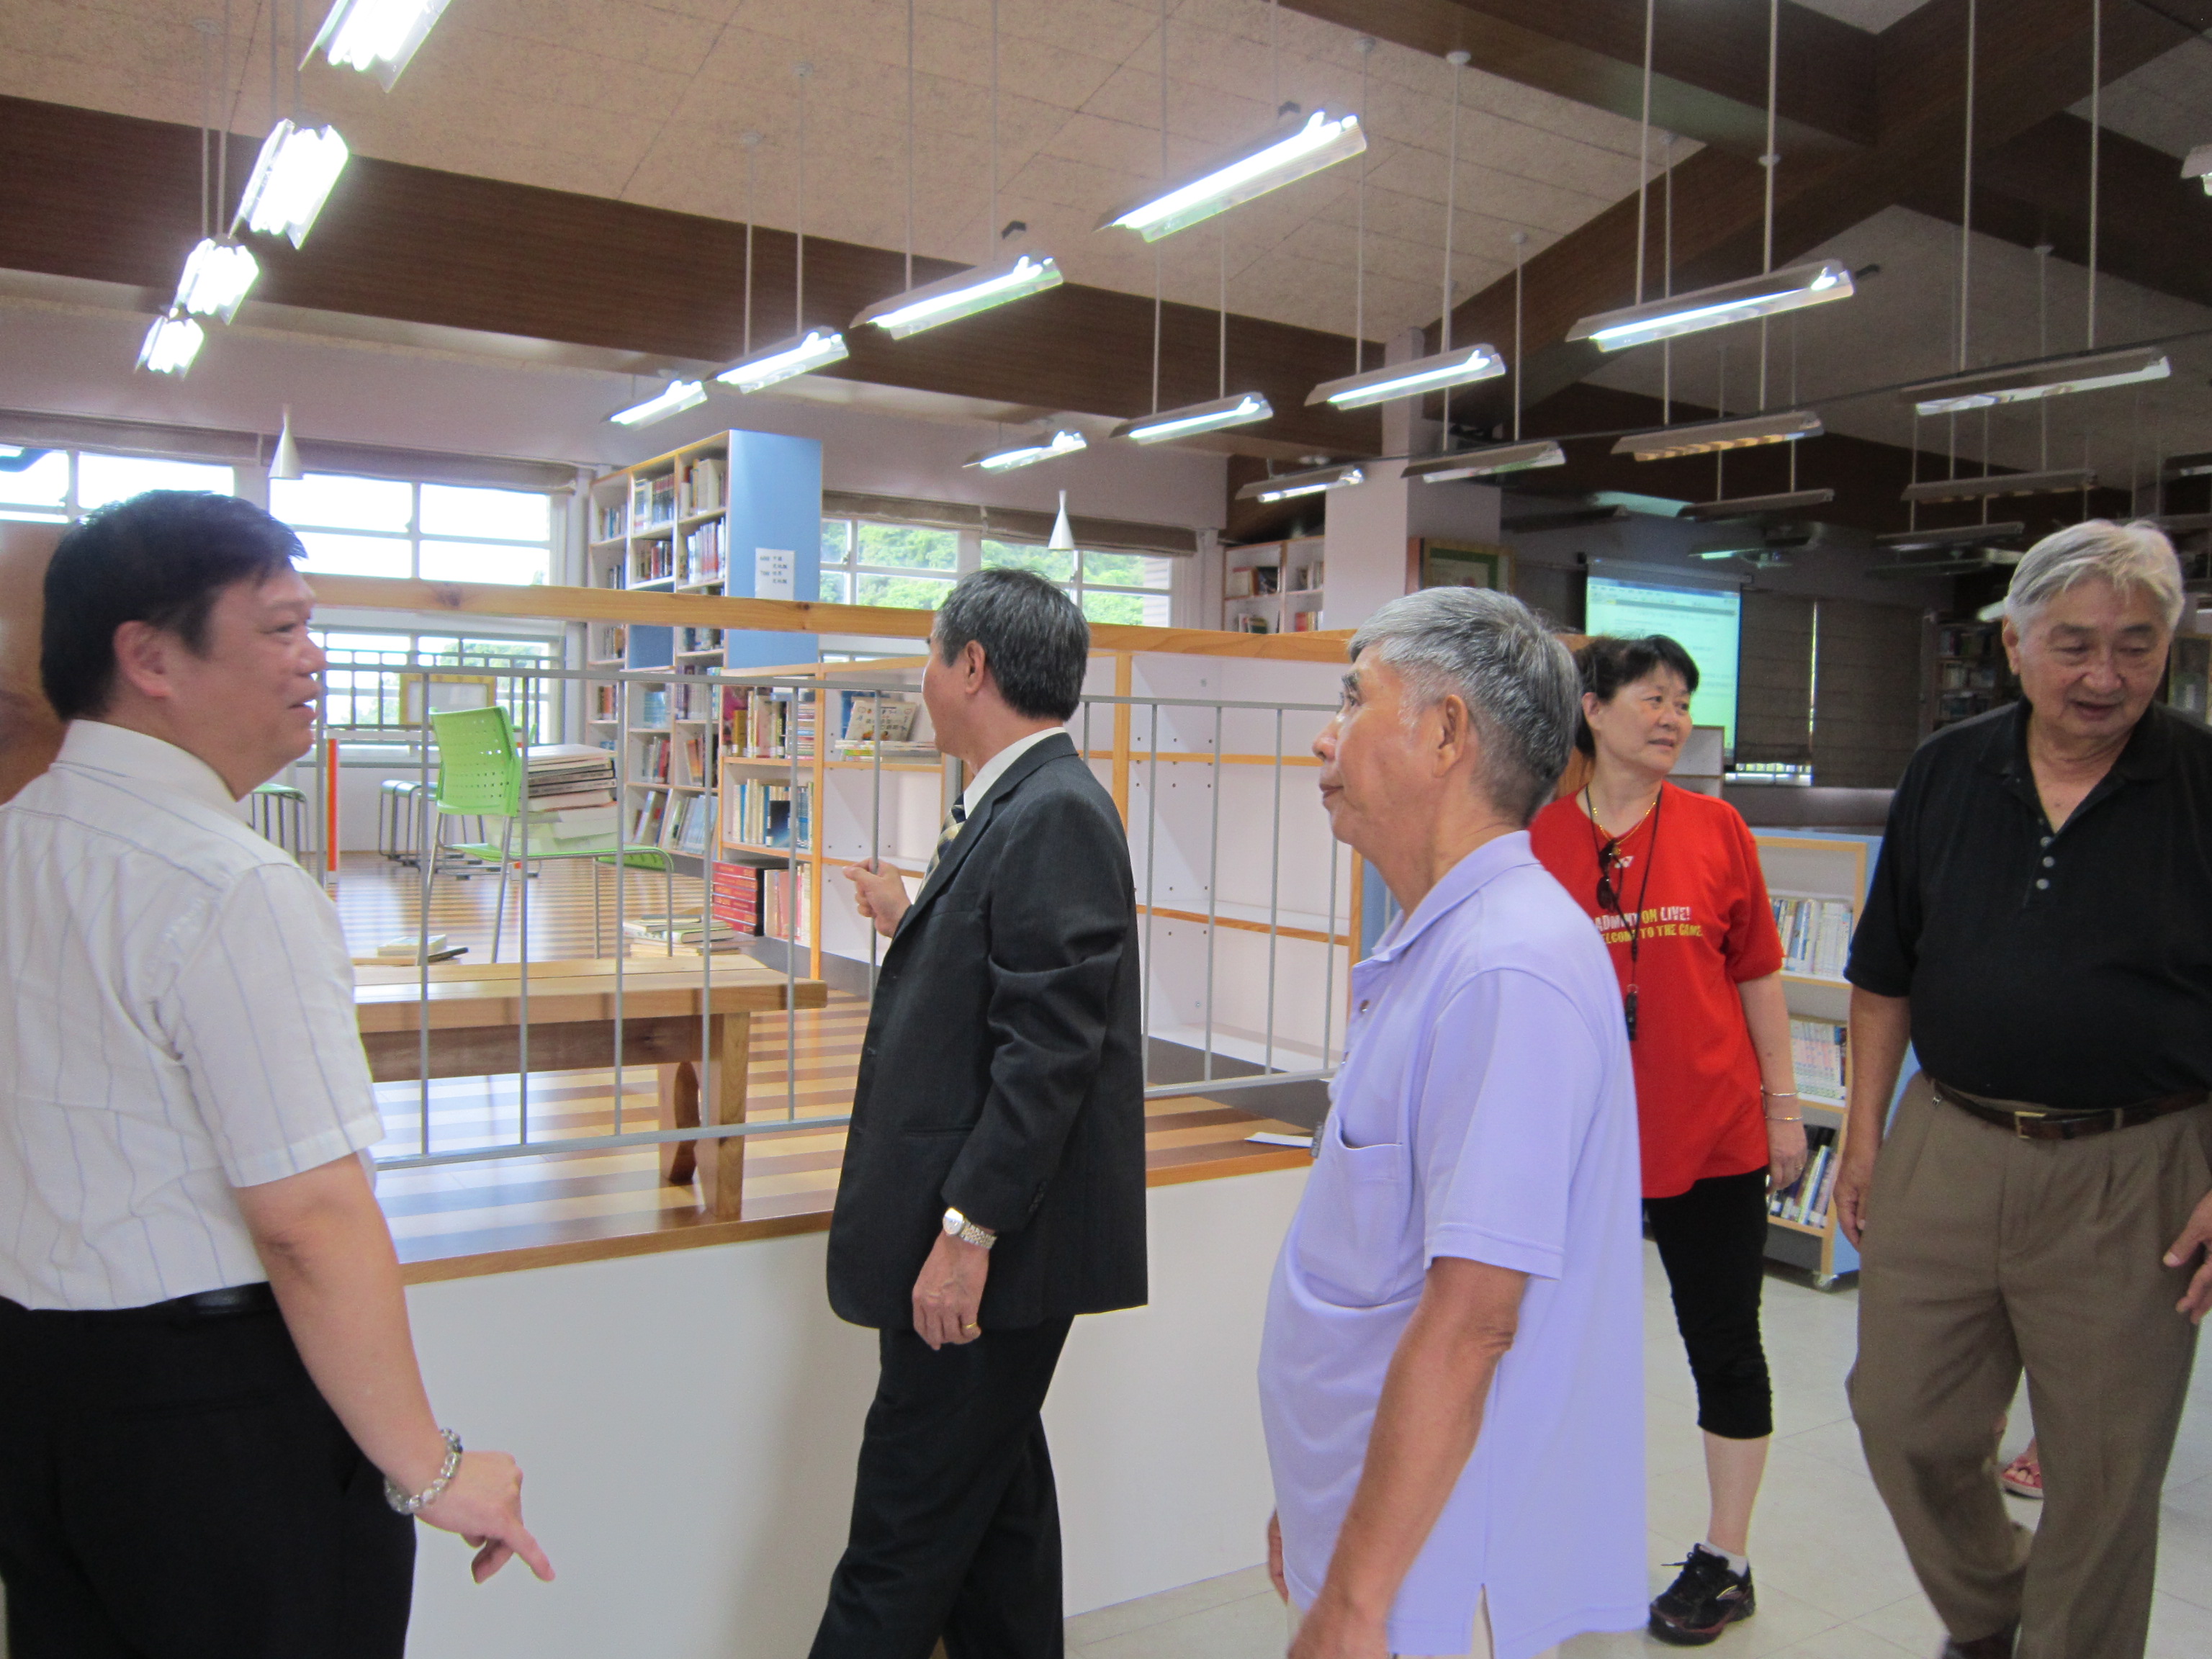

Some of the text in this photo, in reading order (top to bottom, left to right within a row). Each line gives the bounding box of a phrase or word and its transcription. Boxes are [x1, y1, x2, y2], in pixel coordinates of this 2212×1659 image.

[1660, 906, 1690, 921] LIVE!
[1640, 927, 1654, 939] TO
[1657, 925, 1676, 936] THE
